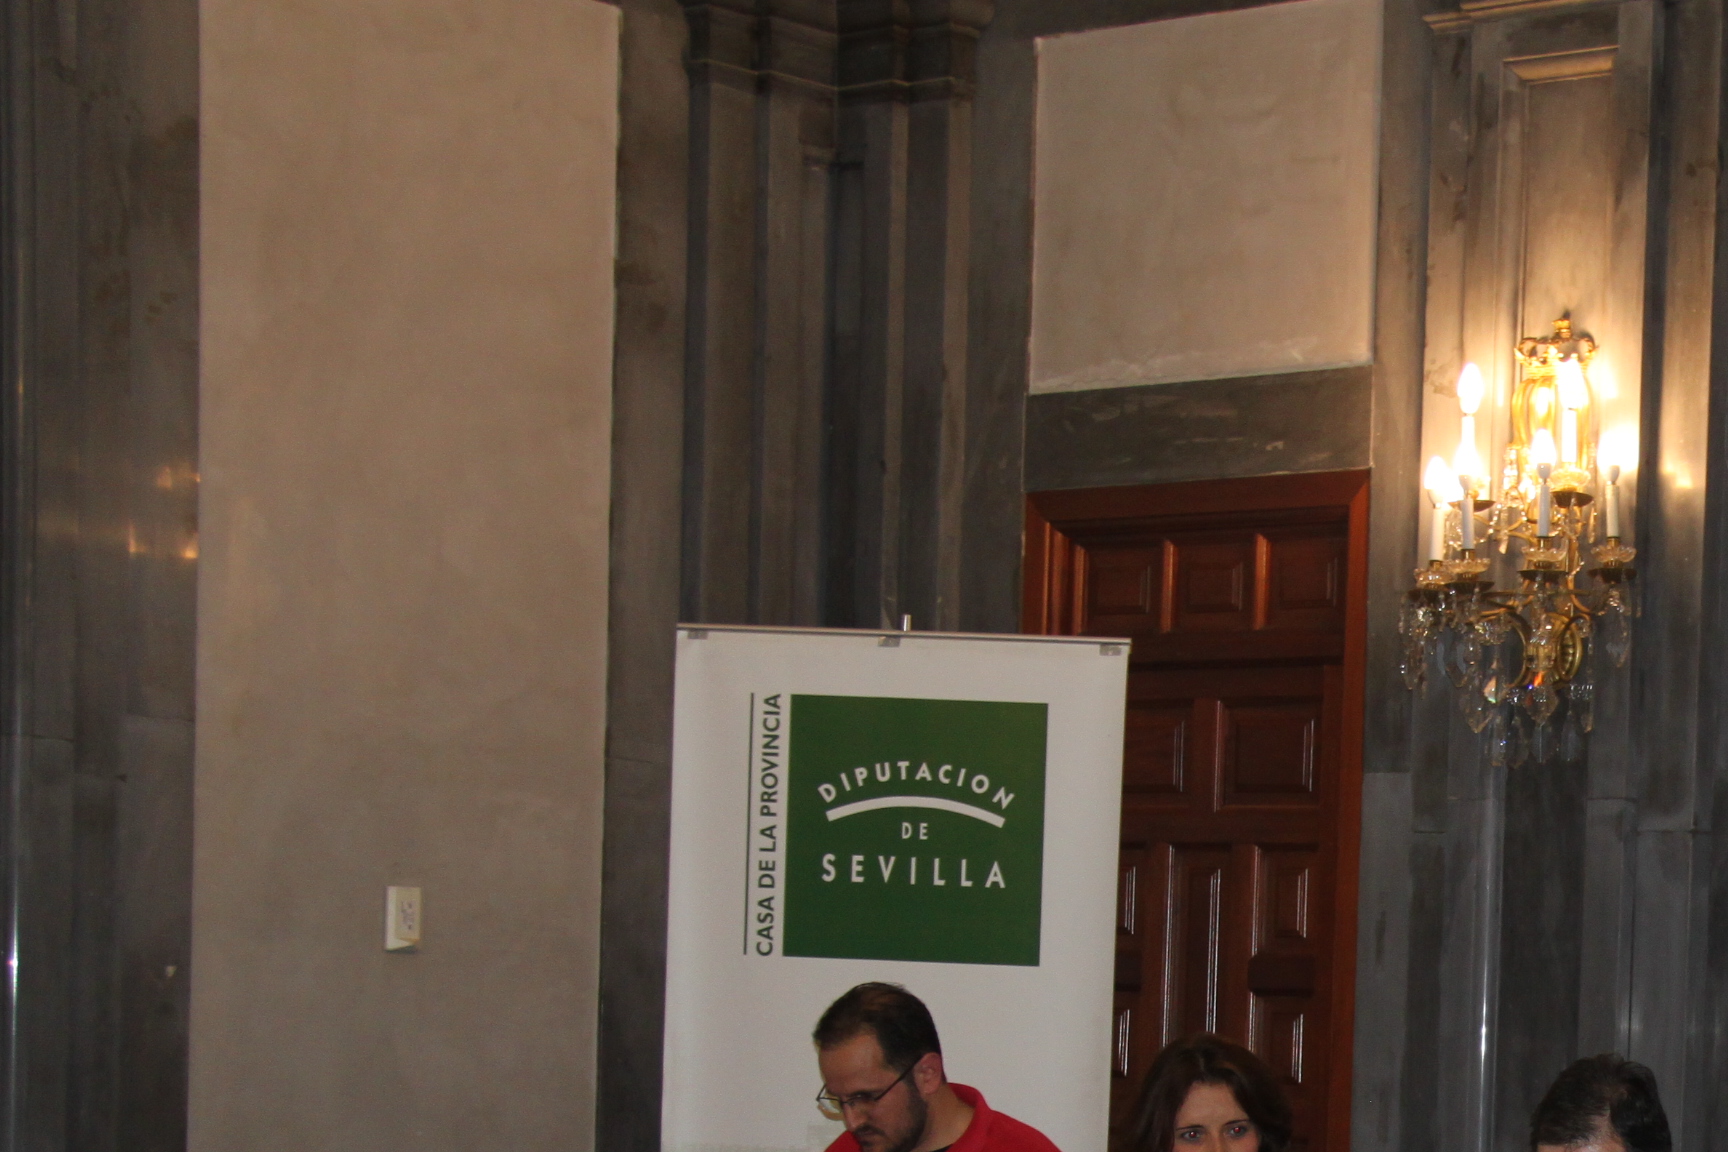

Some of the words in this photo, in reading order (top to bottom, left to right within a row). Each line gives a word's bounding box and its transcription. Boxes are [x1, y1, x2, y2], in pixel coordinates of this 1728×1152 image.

[761, 693, 782, 818] PROVINCIA
[817, 760, 1015, 810] DIPUTACION
[759, 825, 778, 855] LA
[901, 822, 929, 841] DE
[758, 860, 777, 888] DE
[821, 853, 1006, 889] SEVILLA
[756, 897, 775, 957] CASA
